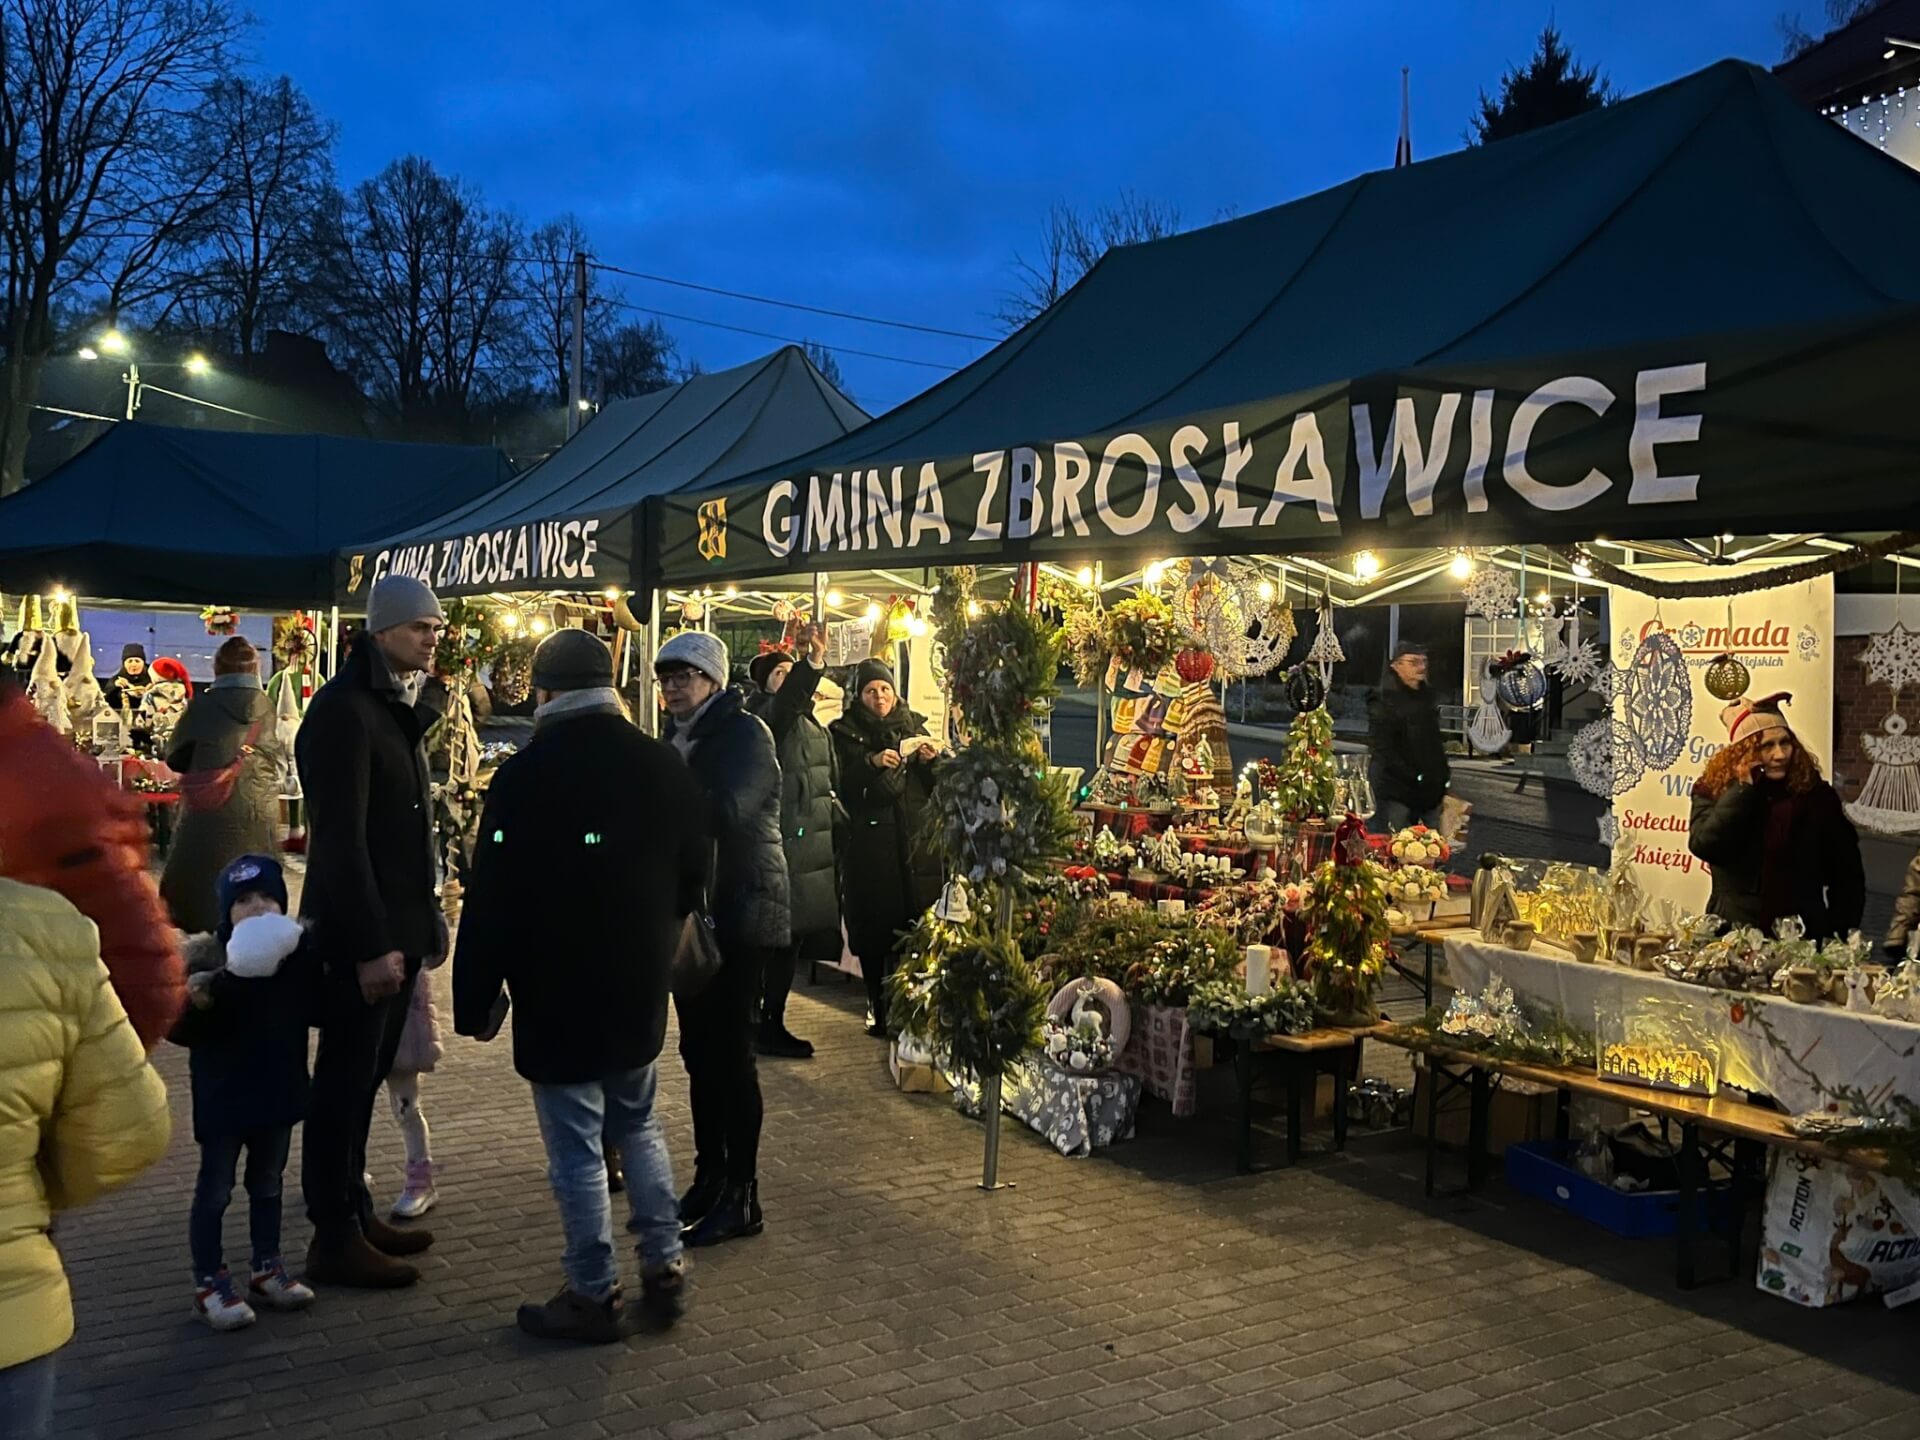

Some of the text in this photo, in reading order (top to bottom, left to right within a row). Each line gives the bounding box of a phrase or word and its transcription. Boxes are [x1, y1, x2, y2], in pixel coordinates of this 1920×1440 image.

[762, 362, 1707, 558] GMINA ZBROSŁAWICE
[371, 519, 600, 589] GMINA ZBROSŁAWICE
[1635, 844, 1693, 874] Księży
[1789, 1175, 1813, 1232] ACTION
